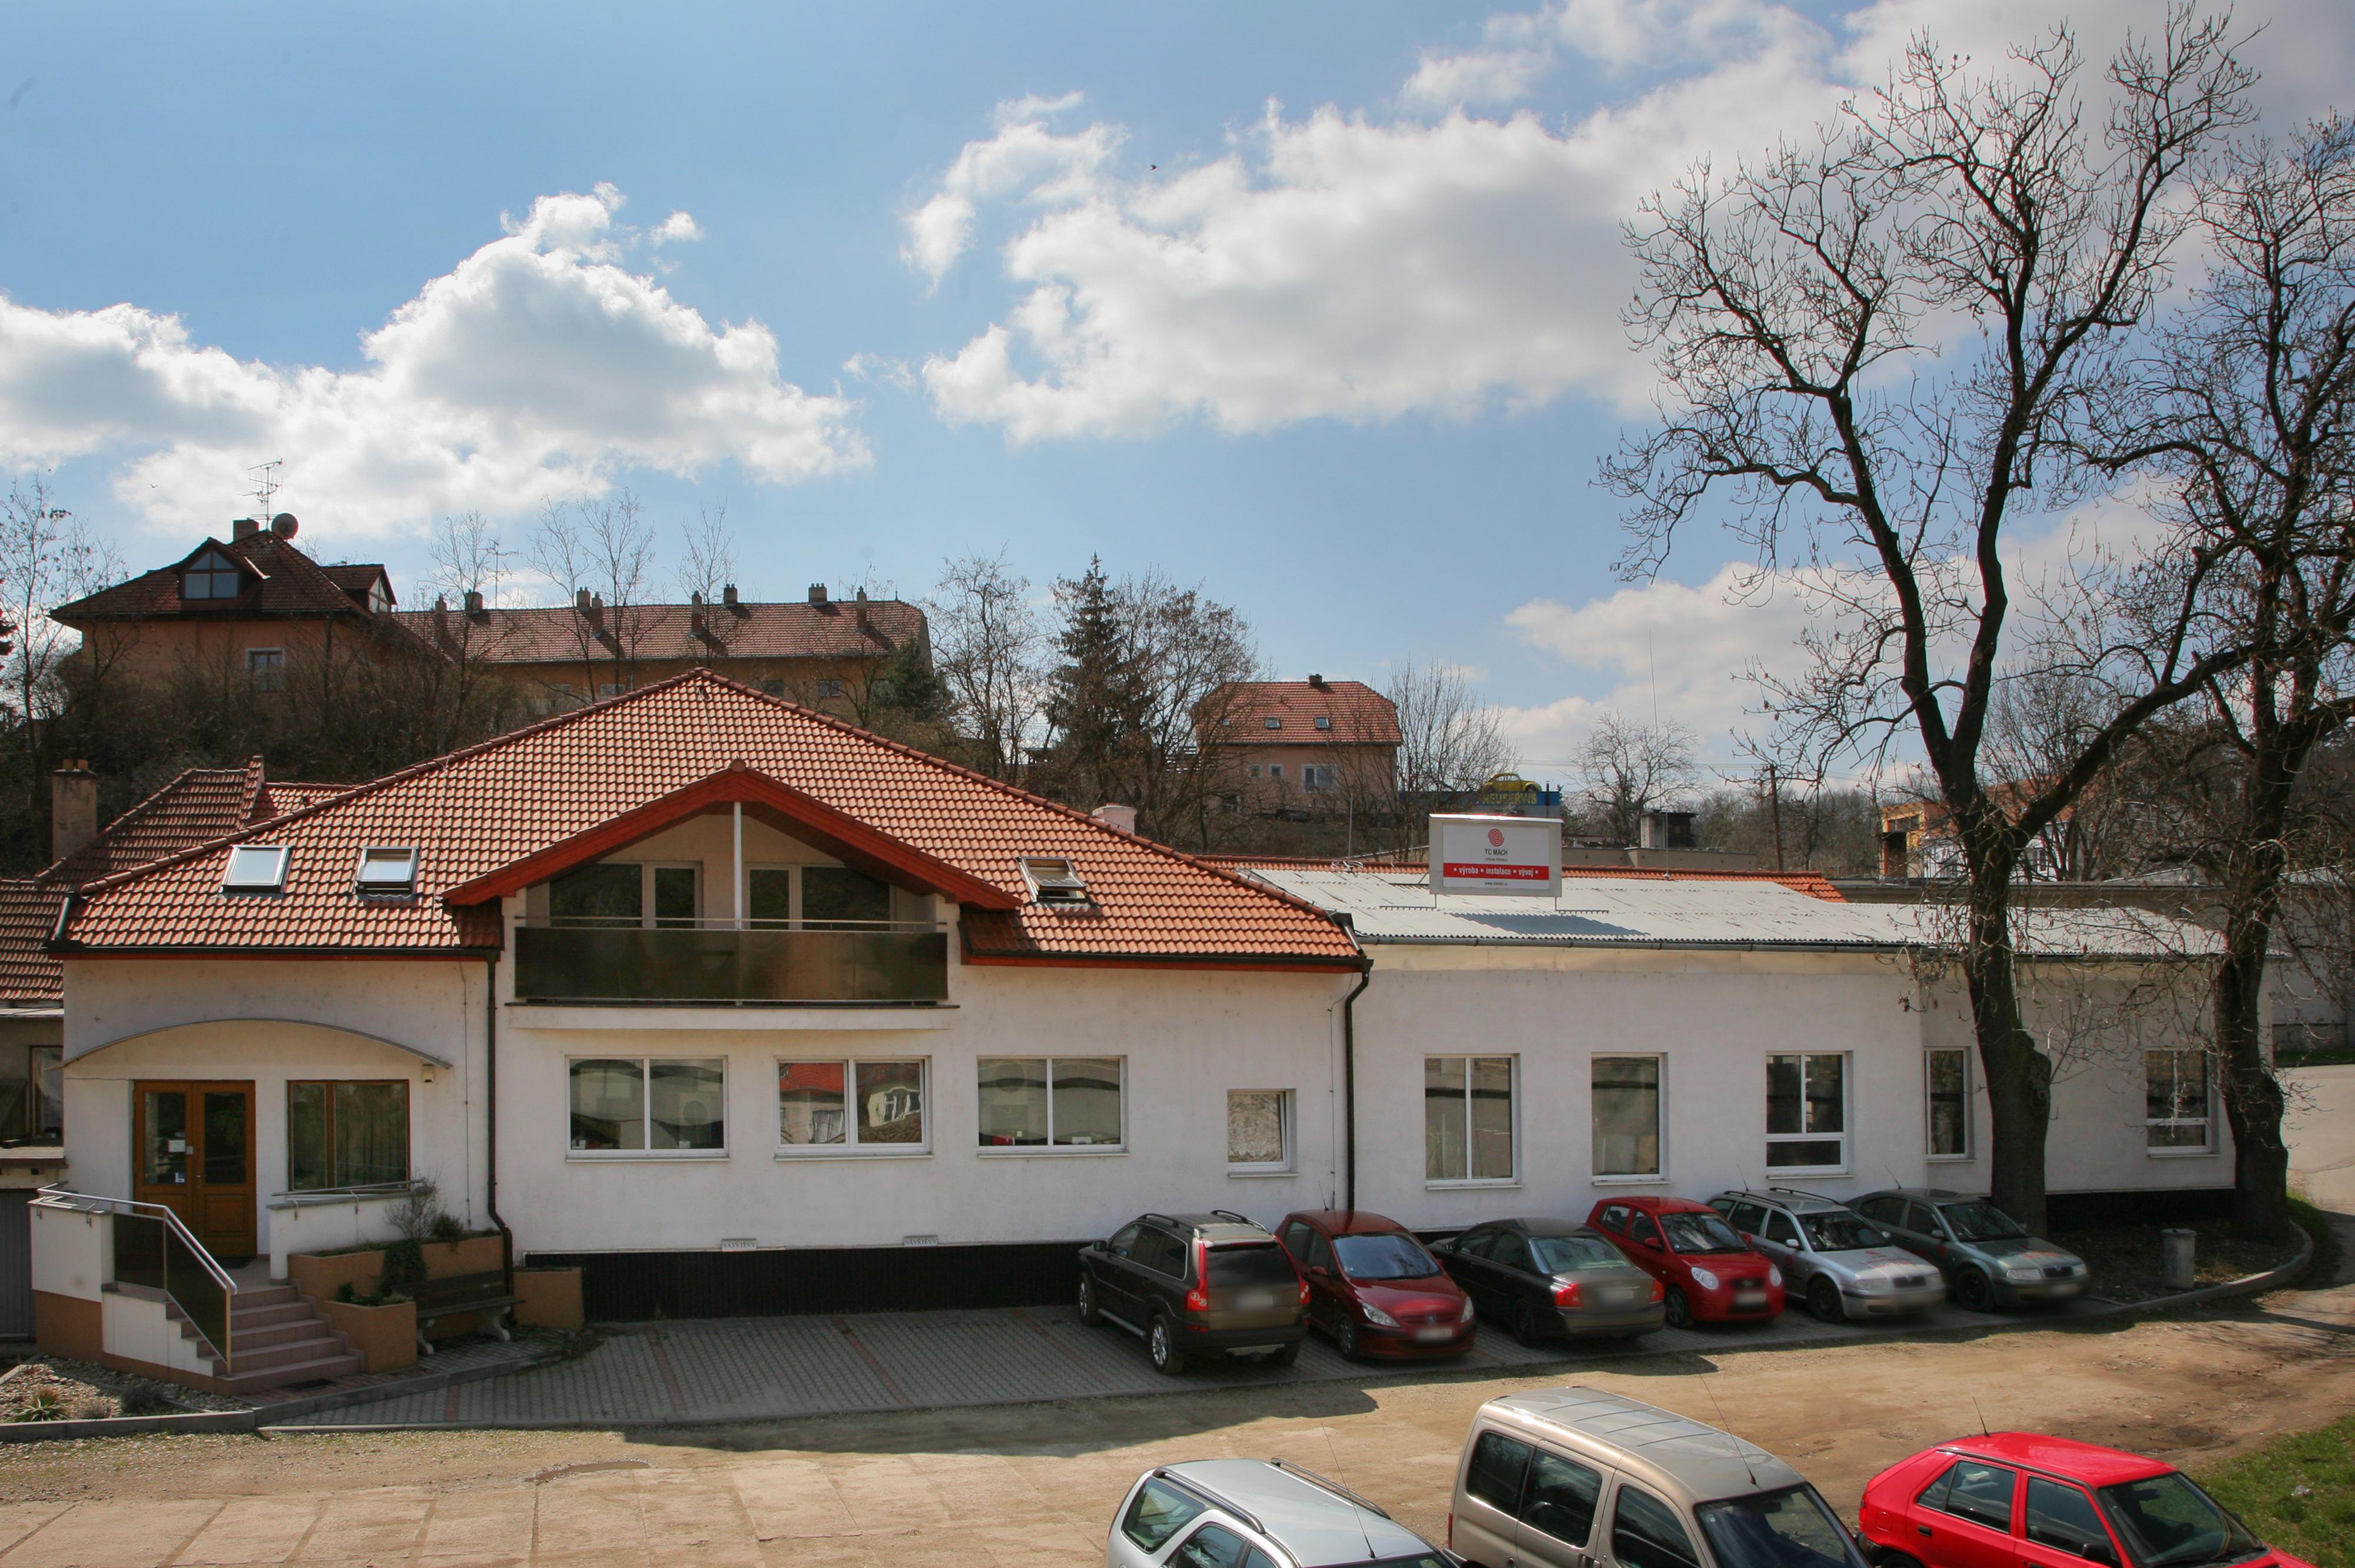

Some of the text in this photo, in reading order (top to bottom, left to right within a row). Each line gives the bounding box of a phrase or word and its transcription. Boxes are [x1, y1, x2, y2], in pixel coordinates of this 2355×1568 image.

[1459, 866, 1533, 877] výroba instalace vývoj
